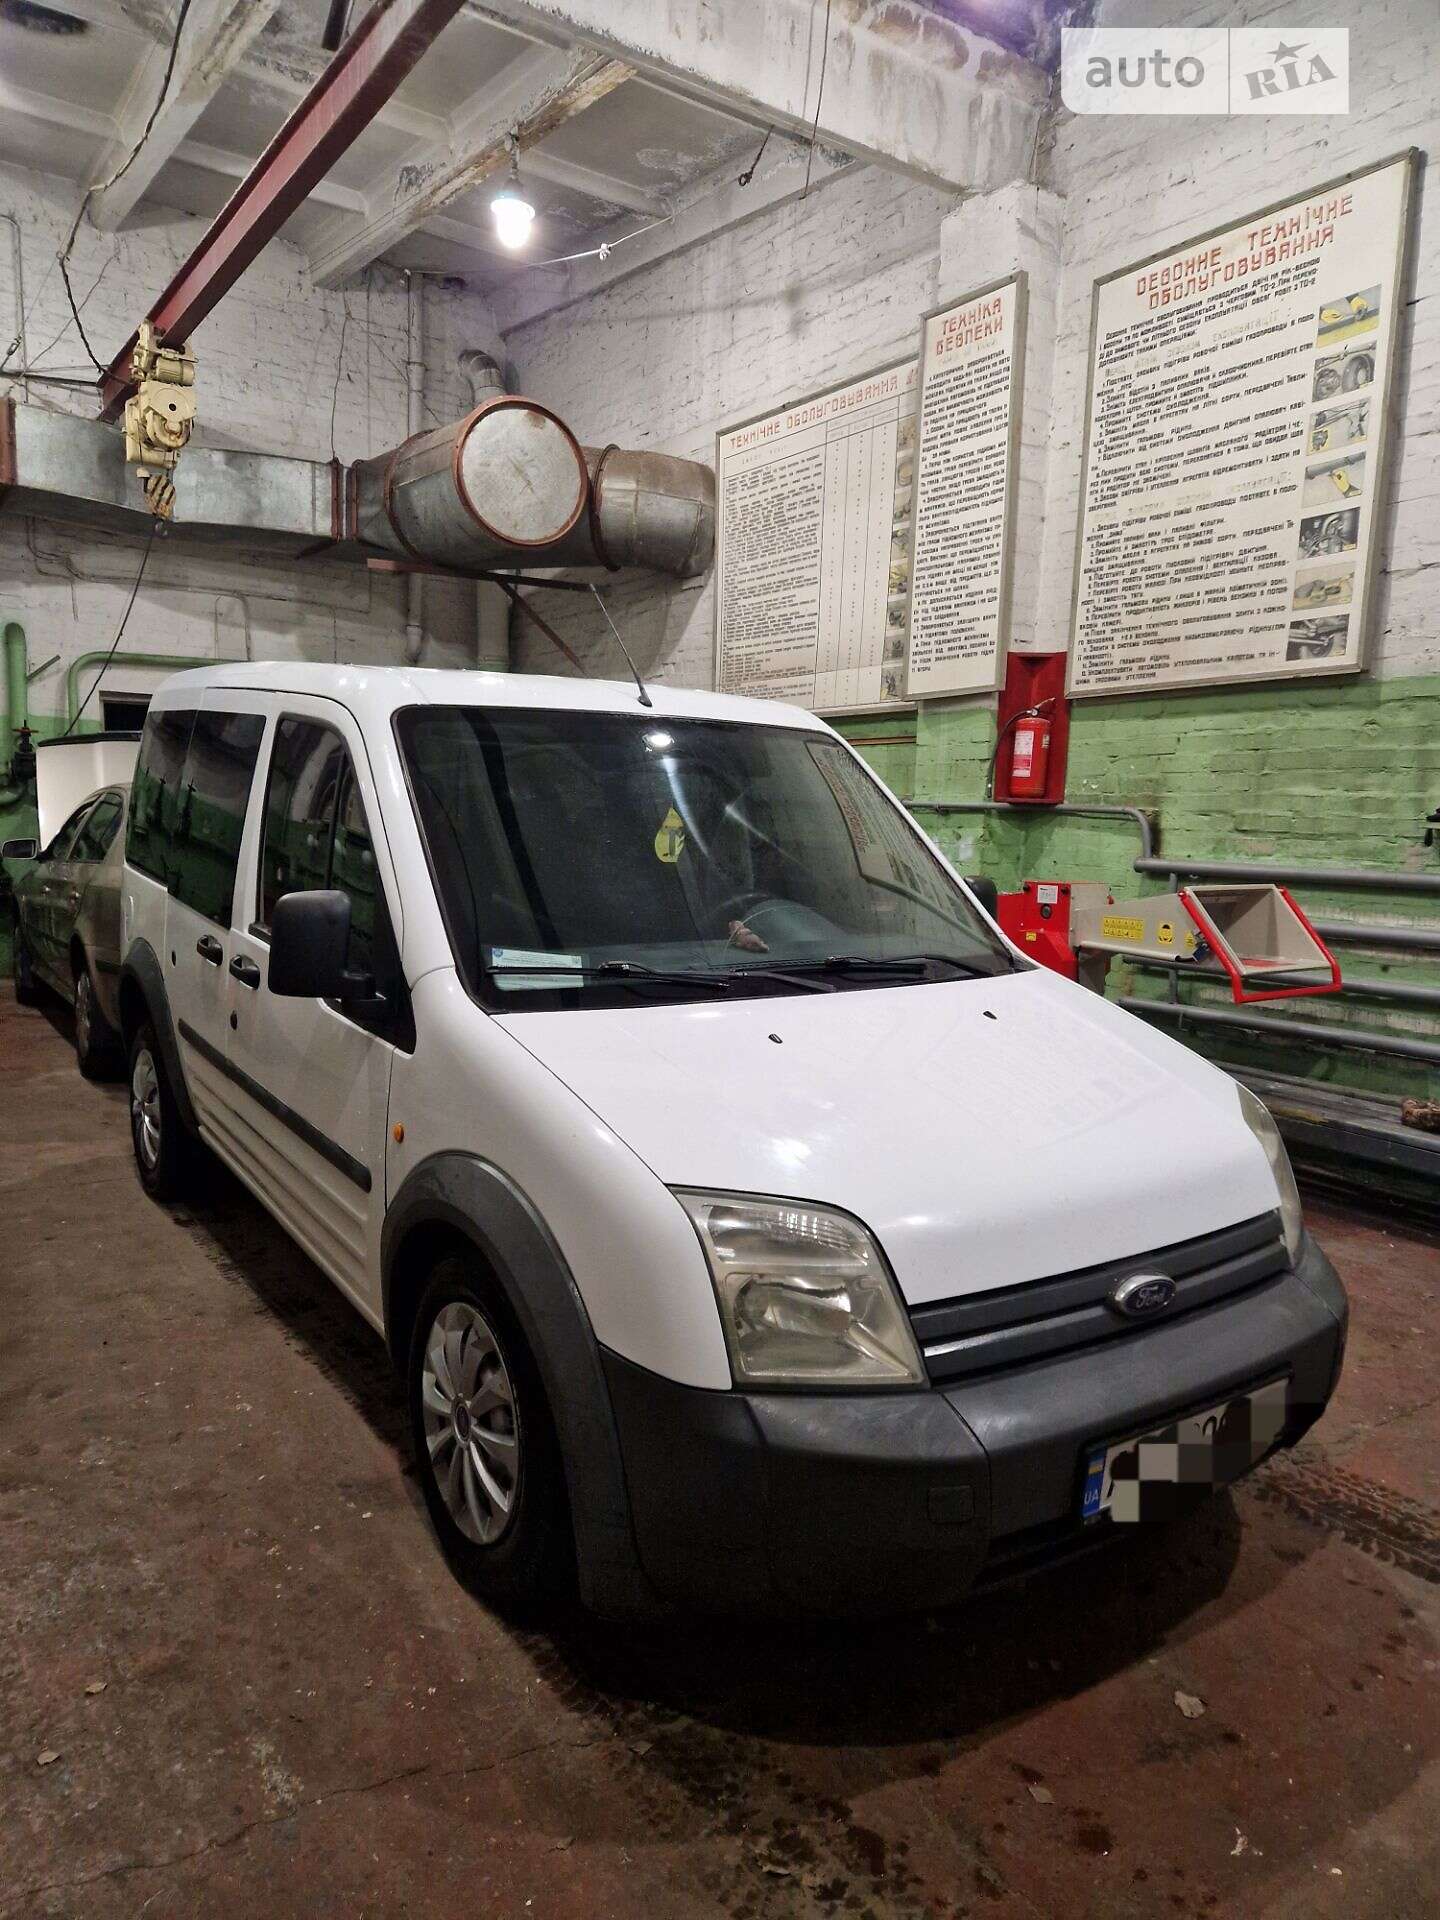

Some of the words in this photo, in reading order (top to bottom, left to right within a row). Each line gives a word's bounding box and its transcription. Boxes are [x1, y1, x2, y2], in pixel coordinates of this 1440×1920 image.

[1135, 245, 1224, 298] СЕЗОННЕ
[1247, 193, 1354, 252] ТЕХНІЧНЕ
[1149, 223, 1335, 311] ОБСЛУГОВУВАННЯ
[935, 316, 1004, 357] БЕЗПЕКИ
[941, 297, 1002, 336] ТЕХНІКА
[729, 420, 781, 449] ТЕХНІЧНЕ
[1084, 1488, 1099, 1505] UA
